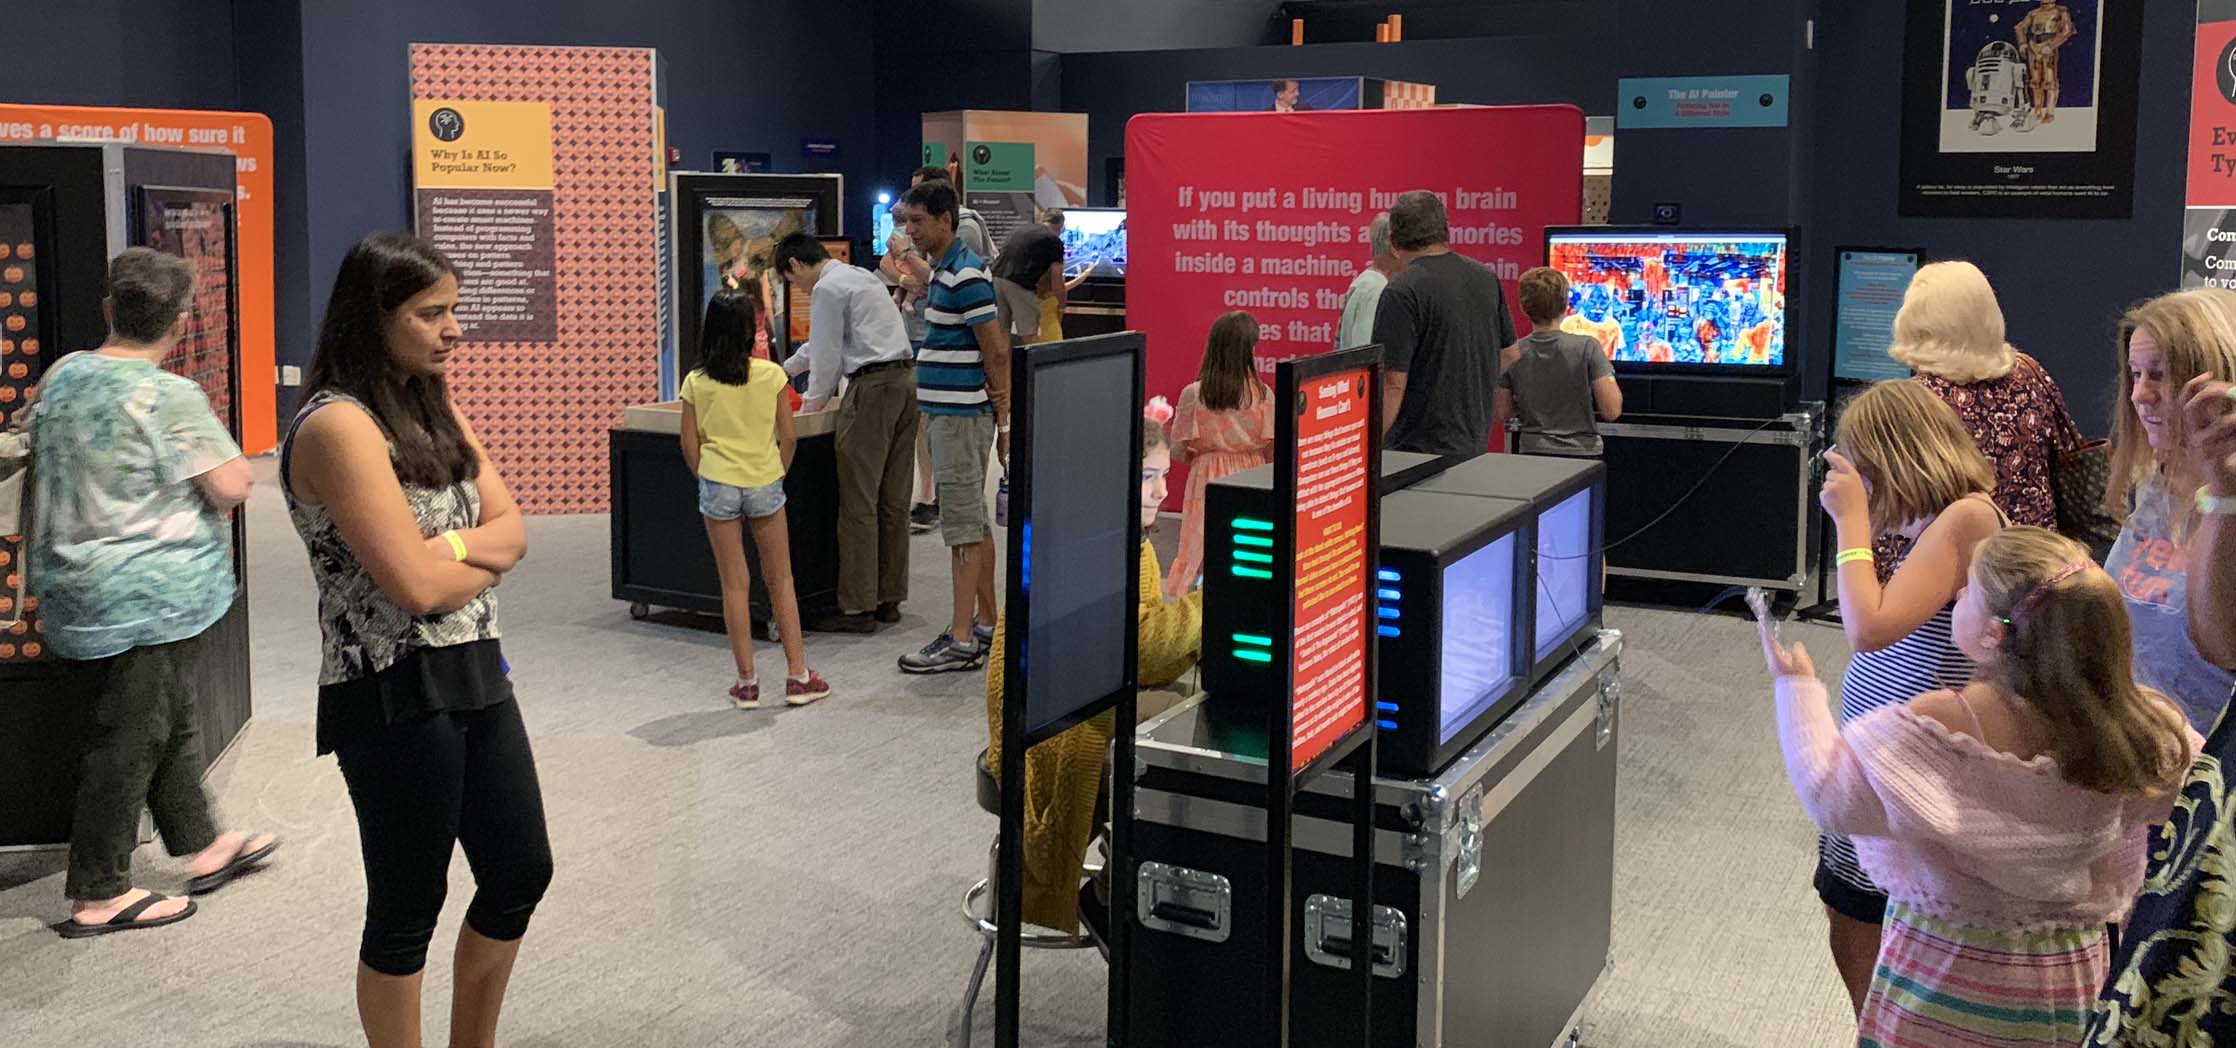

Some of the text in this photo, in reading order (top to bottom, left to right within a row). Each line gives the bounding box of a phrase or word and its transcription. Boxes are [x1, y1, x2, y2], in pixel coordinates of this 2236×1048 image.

[0, 122, 246, 144] ves a score of how sure it
[431, 149, 508, 161] Why Is AI So
[431, 162, 517, 174] Popular Now?
[1993, 166, 2034, 174] Star Wars
[1178, 186, 1517, 213] If you put a living hun brain
[531, 208, 549, 216] way
[1172, 219, 1217, 240] with
[1224, 219, 1249, 241] its
[1256, 219, 1351, 247] thoughts
[1449, 222, 1523, 245] mories
[1175, 251, 1236, 273] inside
[1242, 256, 1254, 274] a
[1261, 254, 1359, 278] machine,
[2204, 276, 2217, 289] to
[1224, 287, 1309, 309] controls
[1288, 320, 1332, 343] that
